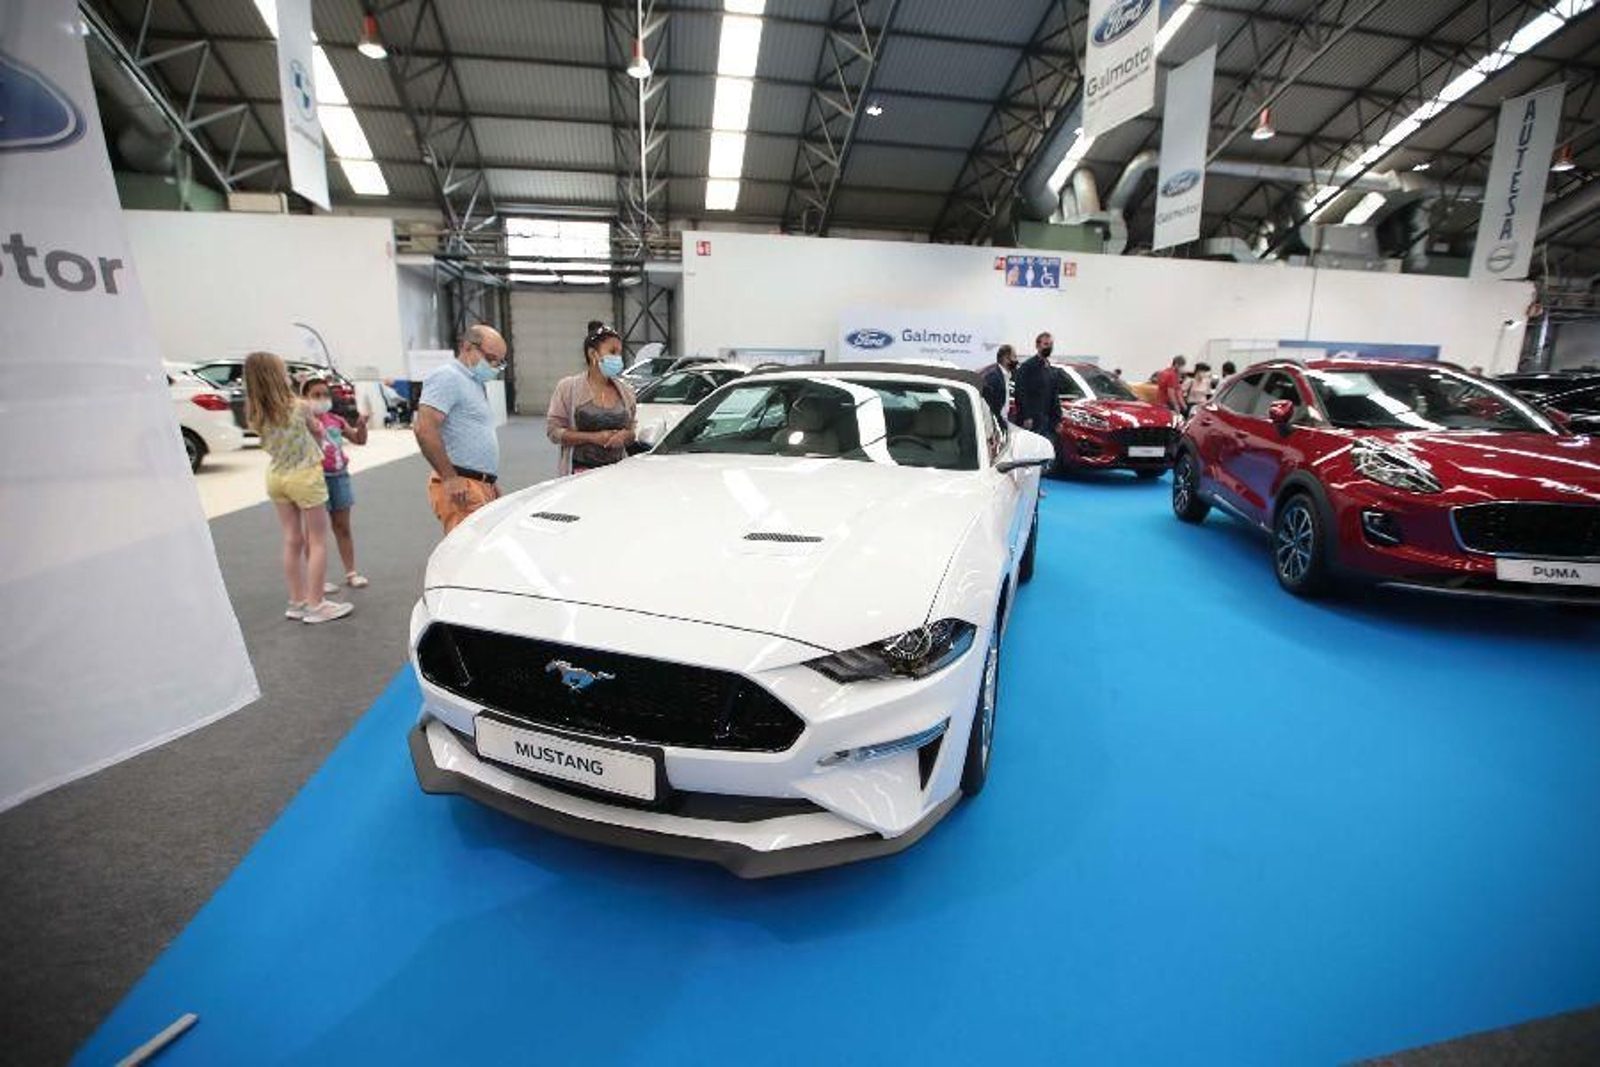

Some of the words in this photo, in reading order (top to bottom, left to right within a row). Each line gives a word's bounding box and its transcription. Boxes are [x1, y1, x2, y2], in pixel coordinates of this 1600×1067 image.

[1103, 0, 1146, 41] Ford
[1499, 99, 1537, 240] AUTESA
[0, 232, 123, 295] tor
[853, 332, 885, 348] Ford
[901, 328, 972, 344] Galmotor
[1533, 566, 1580, 579] PUMA
[514, 741, 604, 776] MUSTANG
